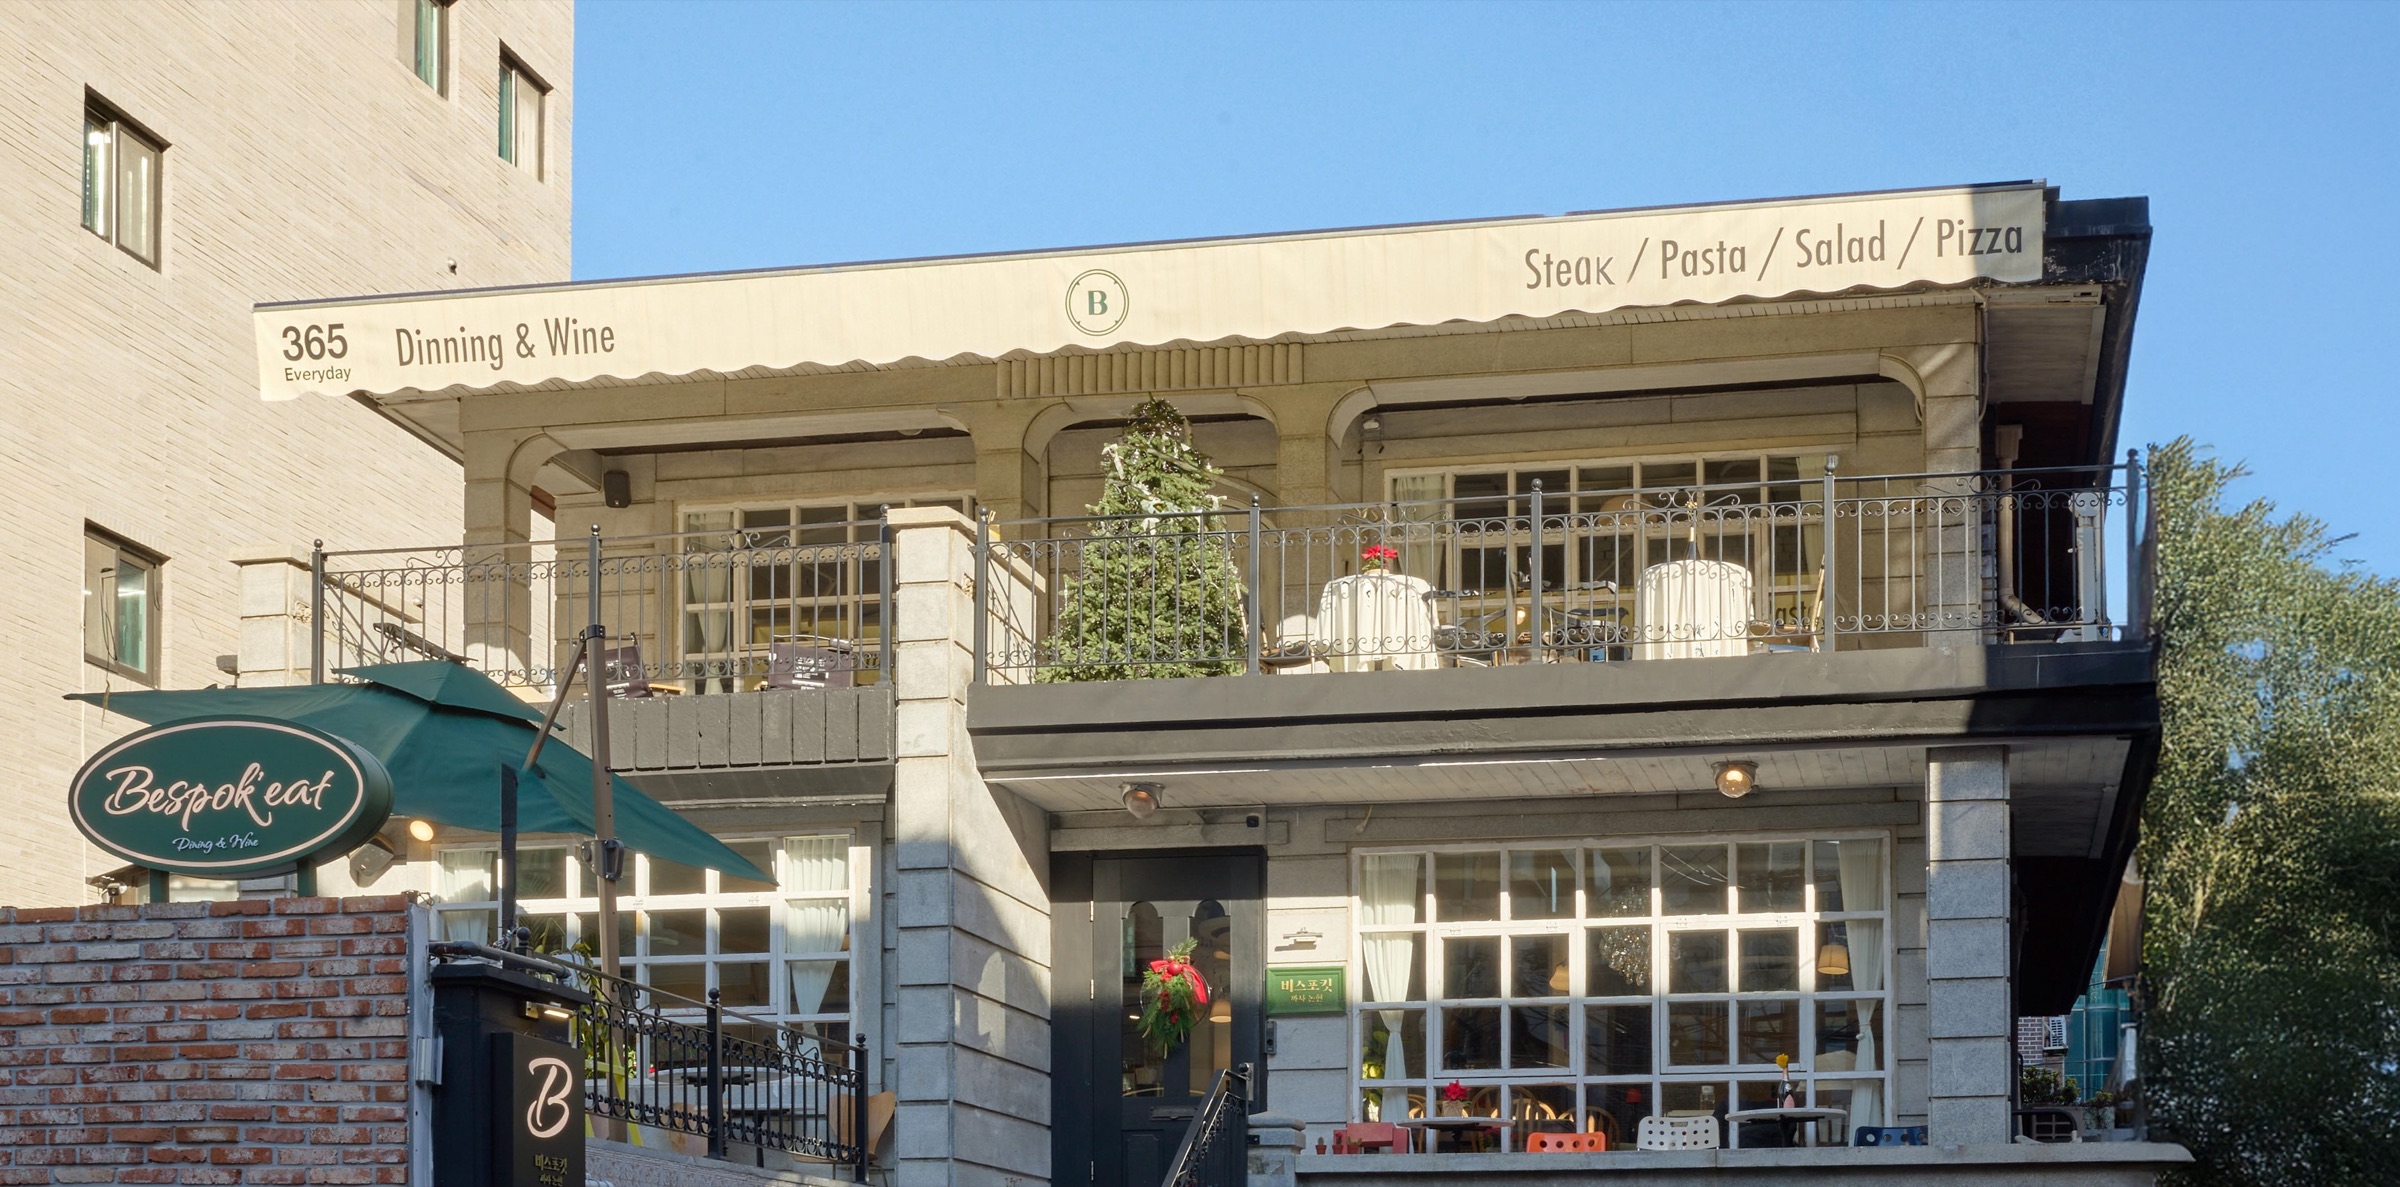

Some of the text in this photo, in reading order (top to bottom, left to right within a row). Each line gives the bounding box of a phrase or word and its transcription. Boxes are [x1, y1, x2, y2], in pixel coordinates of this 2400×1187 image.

[1626, 237, 1650, 284] /
[1661, 239, 1746, 279] Pasta
[1757, 227, 1784, 282] /
[1795, 220, 1886, 268] Salad
[1896, 216, 1925, 270] /
[1937, 218, 2023, 258] Pizza
[1088, 290, 1108, 315] B
[281, 323, 348, 362] 365
[396, 317, 615, 370] Dinning & Wine
[284, 365, 351, 384] Everyday
[172, 831, 259, 854] Dining & Wine
[1281, 978, 1332, 993] 비스포킷
[526, 1057, 573, 1138] B
[535, 1154, 568, 1176] 비스포킷
